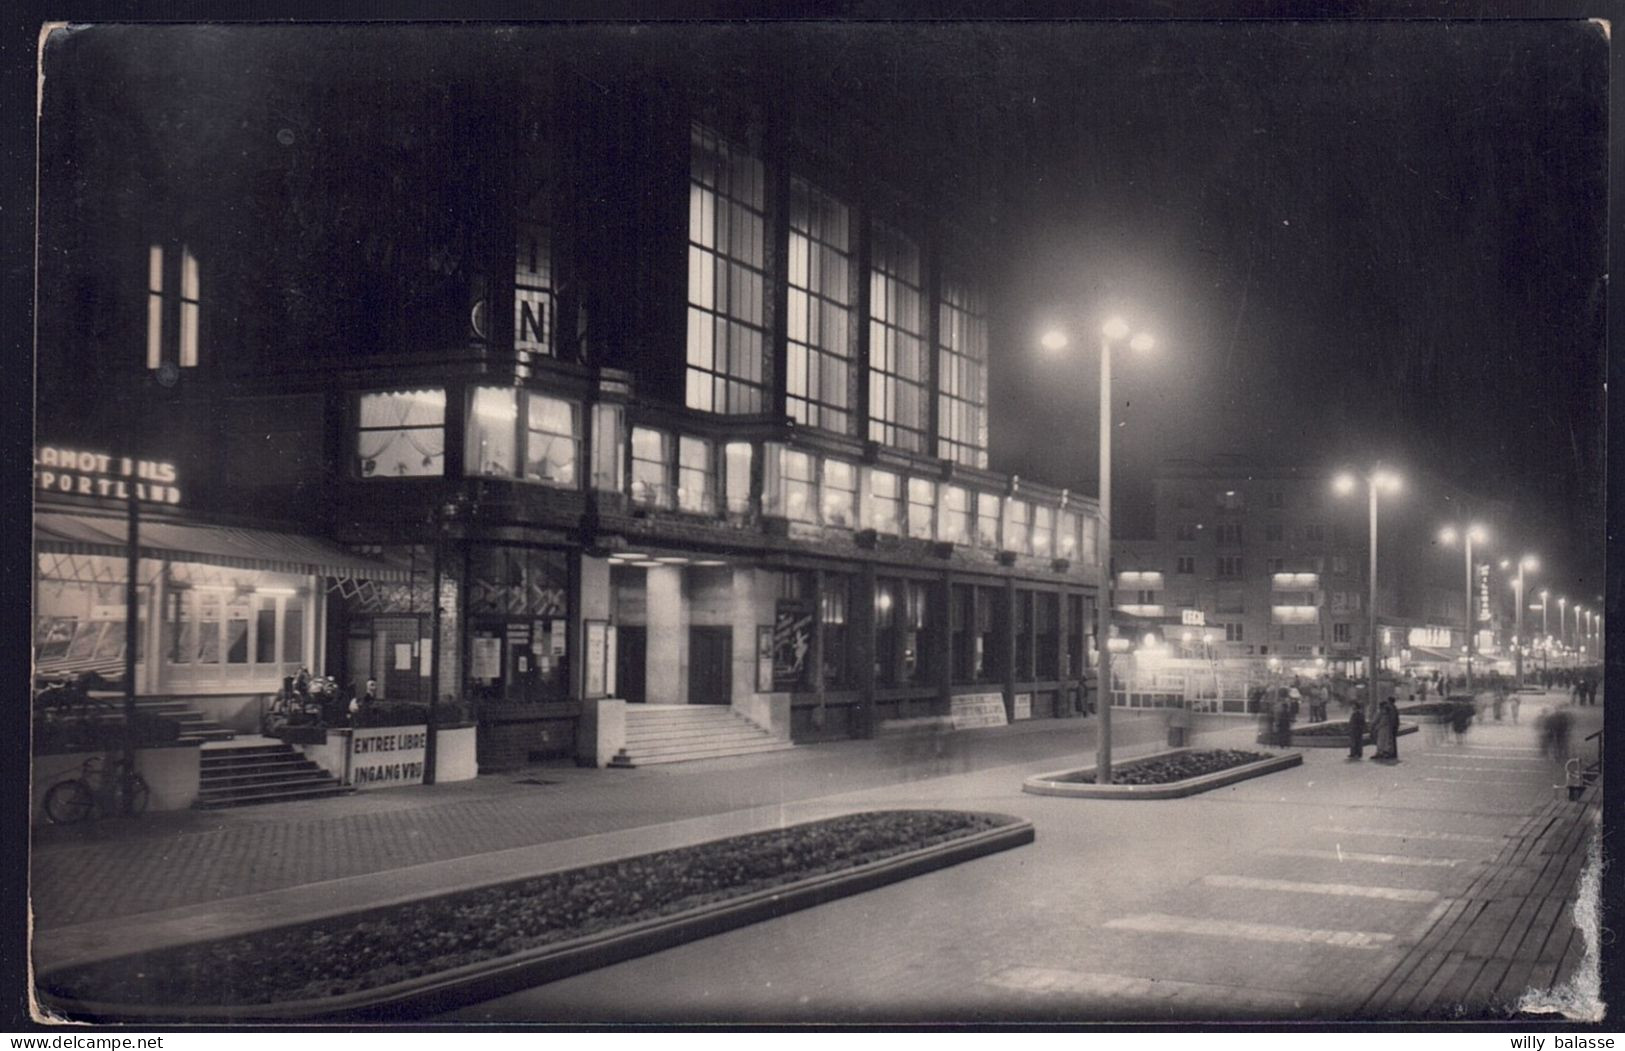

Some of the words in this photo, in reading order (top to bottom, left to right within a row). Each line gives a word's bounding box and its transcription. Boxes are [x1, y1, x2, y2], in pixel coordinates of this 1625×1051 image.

[354, 735, 396, 754] ENTREE
[398, 732, 426, 750] LIBRE
[354, 763, 400, 783] INGANG
